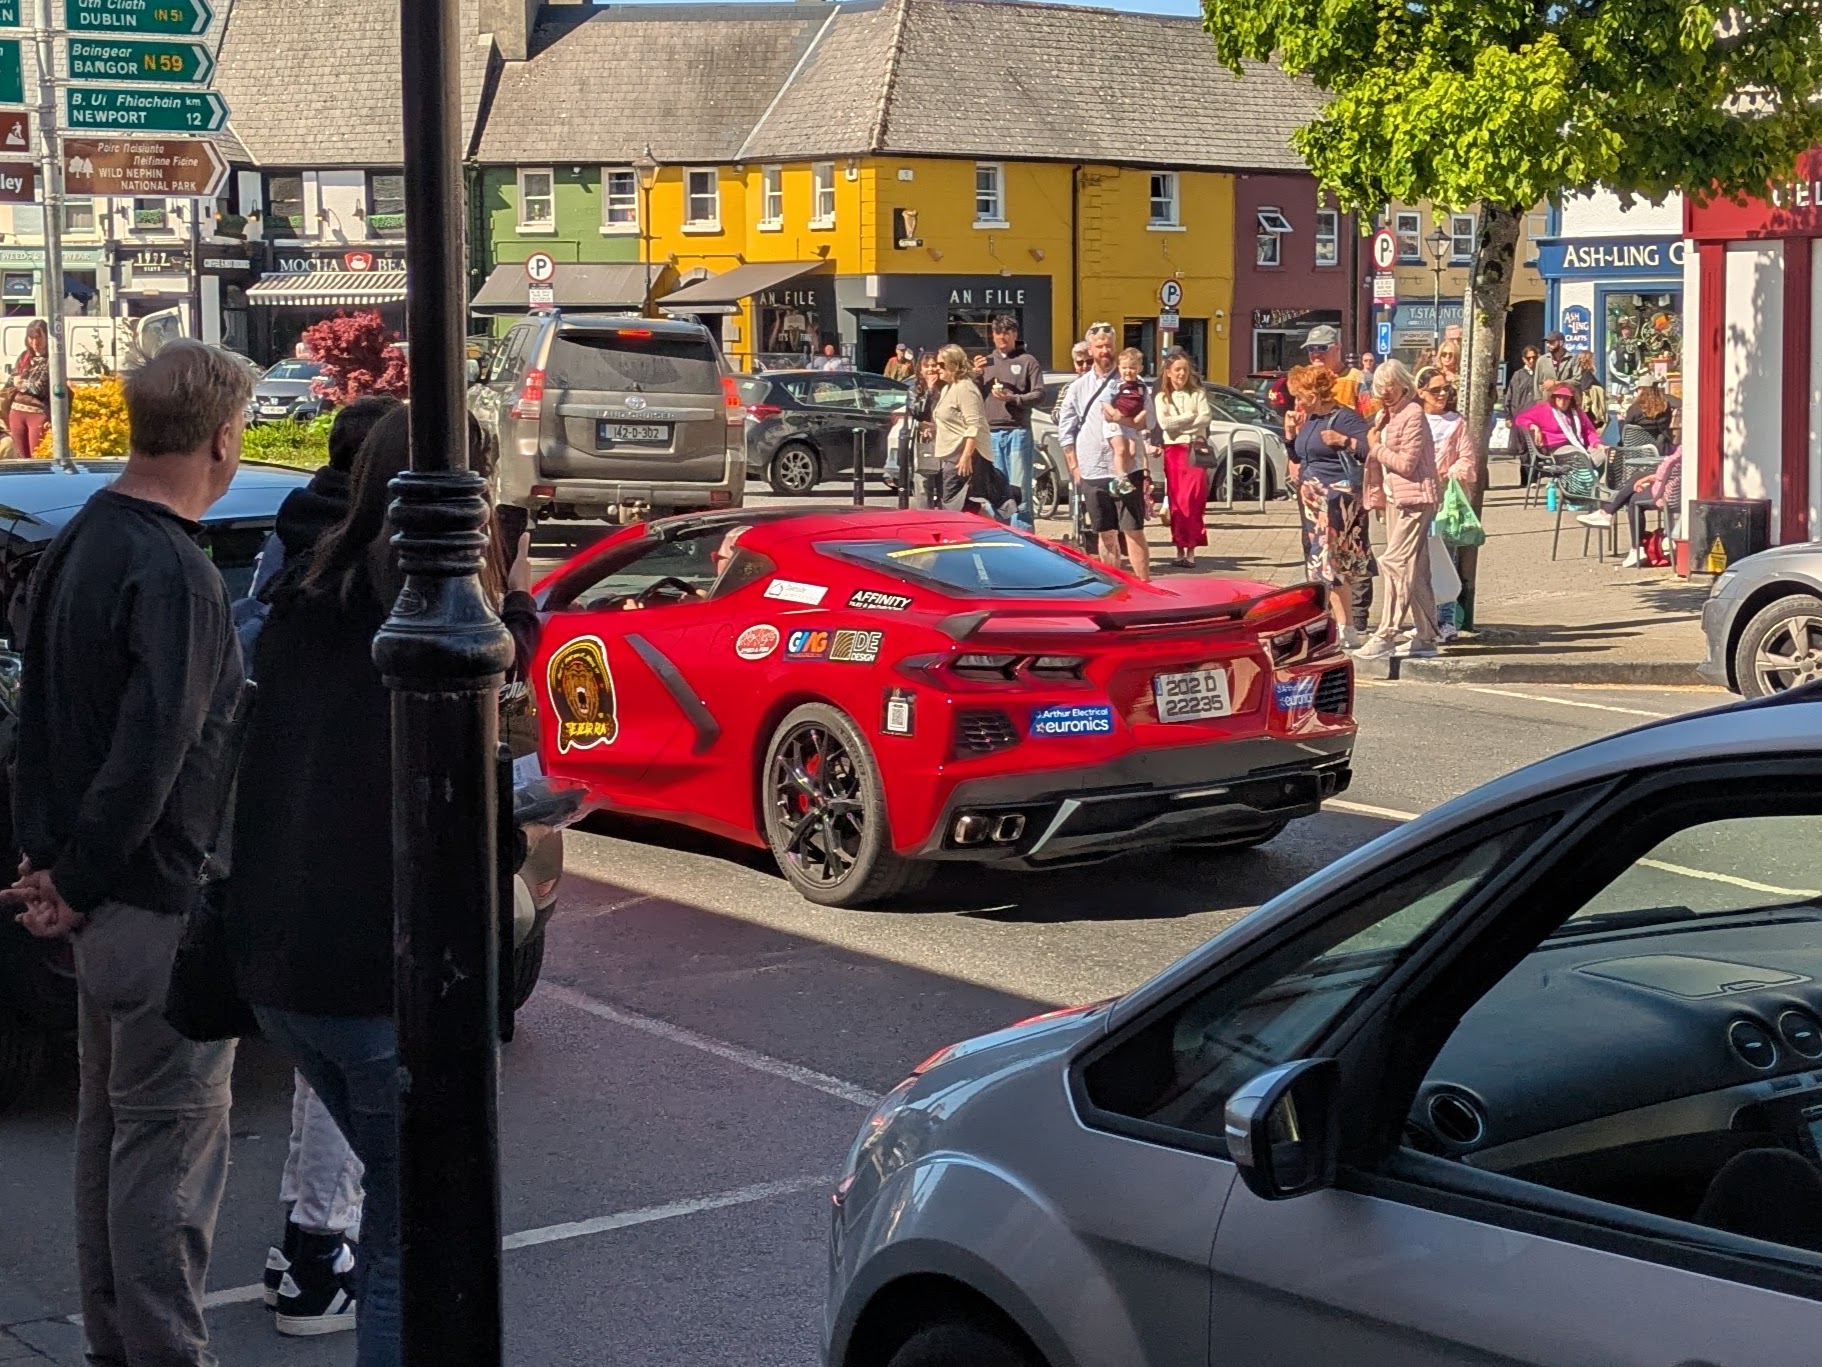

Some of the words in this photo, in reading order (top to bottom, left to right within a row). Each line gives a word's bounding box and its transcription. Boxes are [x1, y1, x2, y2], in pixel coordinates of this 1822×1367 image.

[107, 0, 146, 10] Cliath
[80, 12, 137, 26] DUBLIN
[72, 43, 133, 59] Baingear
[74, 60, 138, 75] BANGOR
[144, 54, 156, 70] N
[160, 54, 183, 72] 59
[72, 93, 86, 106] B.
[185, 97, 201, 106] km
[73, 109, 147, 124] NEWPORT
[186, 112, 202, 126] 12
[98, 168, 122, 178] WILD
[126, 168, 163, 179] NEPHIN
[121, 181, 169, 191] NATIONAL
[172, 181, 197, 192] PARK
[1380, 238, 1390, 263] P
[278, 258, 340, 272] MOCHA
[536, 258, 547, 277] P
[760, 291, 776, 305] AN
[785, 291, 816, 306] FILE
[949, 289, 972, 304] AN
[985, 289, 1025, 304] FILE
[1167, 285, 1177, 303] P
[1563, 311, 1580, 324] ASH
[1381, 326, 1388, 336] P
[851, 590, 912, 608] AFFINITY
[853, 630, 882, 652] DE
[1166, 677, 1202, 697] 202
[1072, 707, 1109, 717] Electrical
[1165, 694, 1223, 716] 22235
[1045, 716, 1110, 733] euronics
